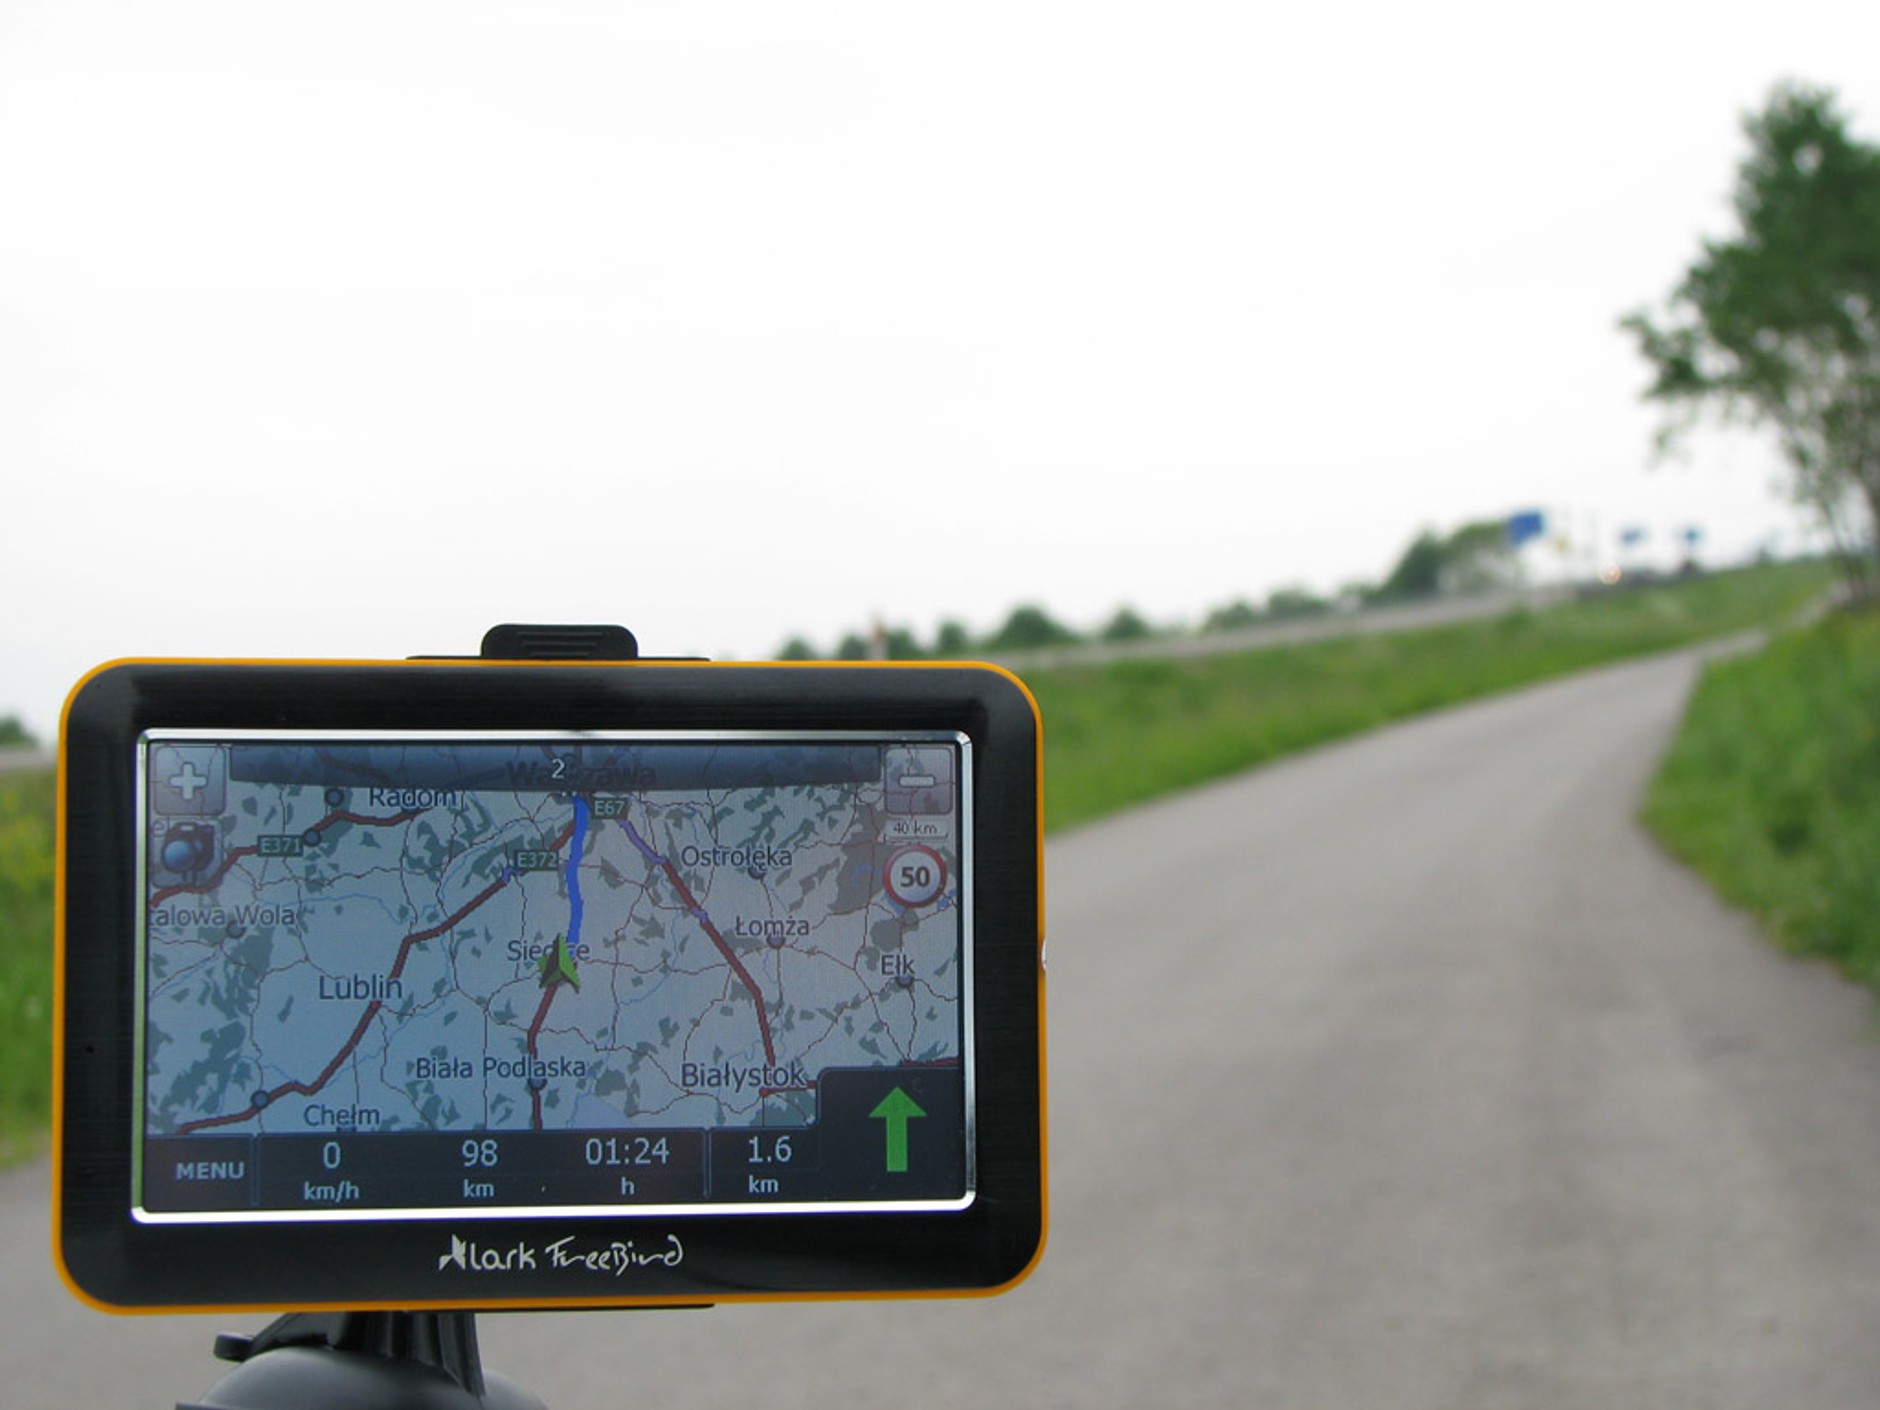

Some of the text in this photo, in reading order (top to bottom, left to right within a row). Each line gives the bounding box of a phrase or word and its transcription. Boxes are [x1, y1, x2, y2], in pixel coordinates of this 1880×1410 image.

[551, 758, 565, 779] 2
[369, 786, 457, 808] Radom
[594, 800, 626, 816] E67
[893, 820, 938, 835] 40 km
[261, 837, 301, 853] E371
[517, 852, 557, 868] E372
[681, 845, 793, 869] Ostrołęka
[900, 866, 930, 888] 50
[236, 905, 296, 926] Wola
[735, 915, 810, 937] Łomża
[507, 939, 591, 962] Siece
[881, 953, 916, 976] Ełk
[319, 973, 402, 1000] Lublin
[416, 1055, 586, 1079] Biała Podlaska
[681, 1062, 807, 1093] Białystok
[304, 1103, 380, 1126] Chełm
[322, 1141, 341, 1169] 0
[462, 1139, 498, 1167] 98
[585, 1137, 670, 1165] 01:24
[748, 1135, 793, 1164] 1.6
[176, 1161, 245, 1180] MENU
[304, 1181, 359, 1202] km/h
[463, 1179, 495, 1198] km
[621, 1177, 635, 1195] h
[748, 1174, 779, 1193] km
[470, 1234, 684, 1277] lark FreeBird
